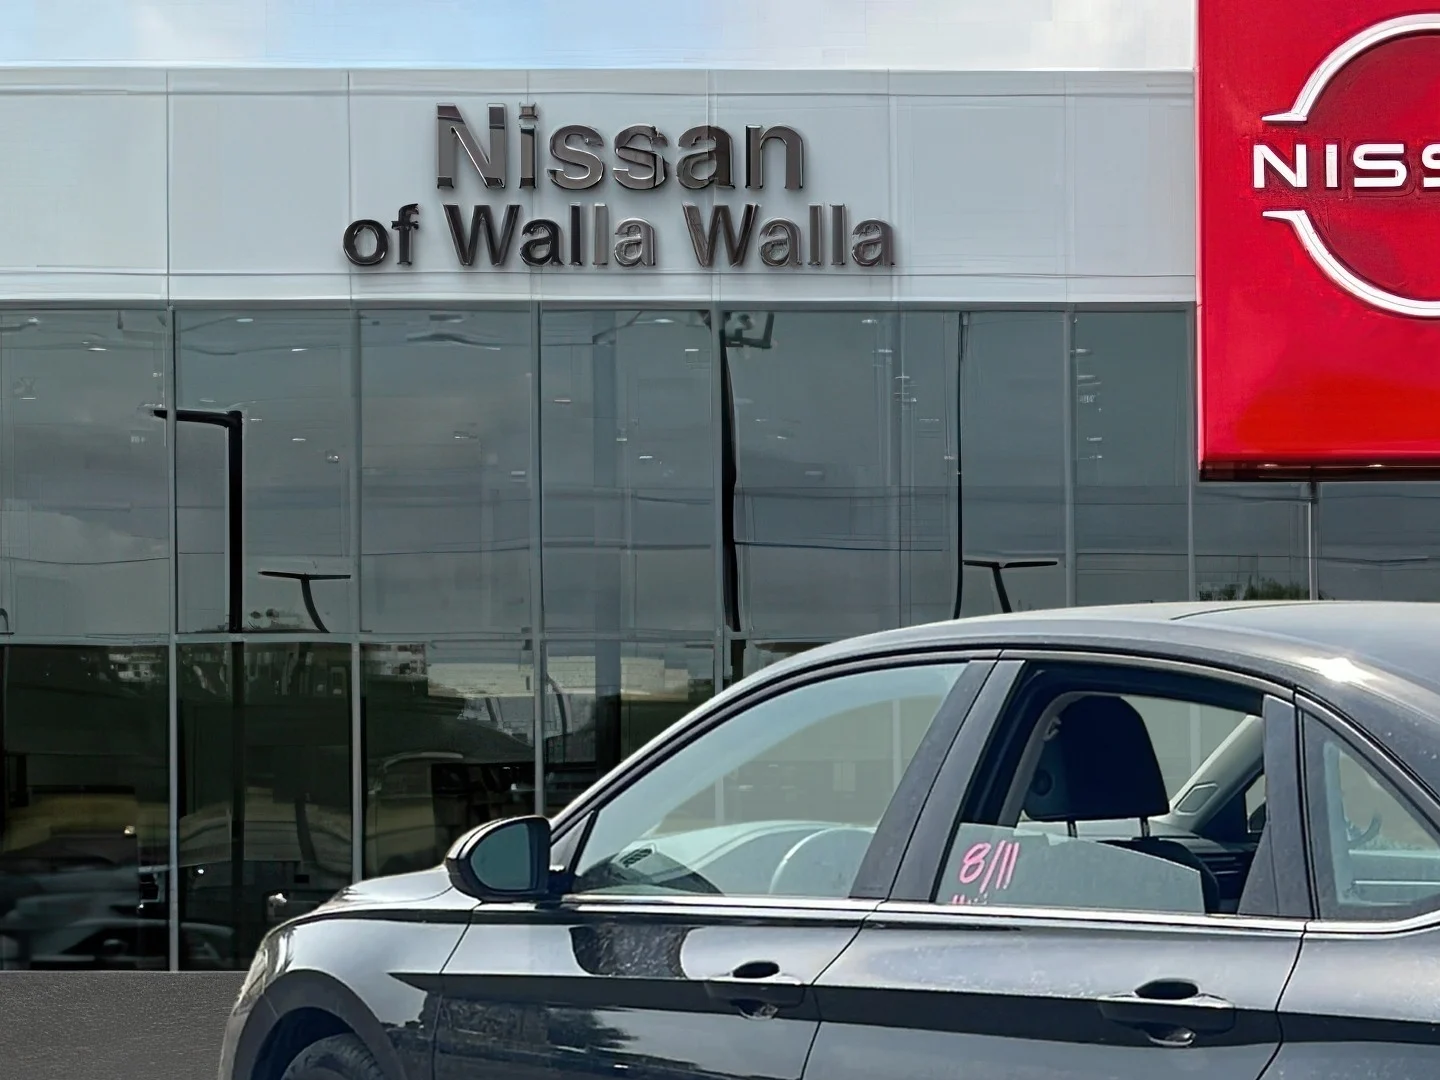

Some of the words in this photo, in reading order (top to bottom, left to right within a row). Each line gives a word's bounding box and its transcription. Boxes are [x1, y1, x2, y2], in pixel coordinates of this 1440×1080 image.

[435, 102, 804, 190] Nissan
[342, 203, 420, 267] of
[442, 204, 657, 267] Walla
[682, 203, 896, 267] Walla
